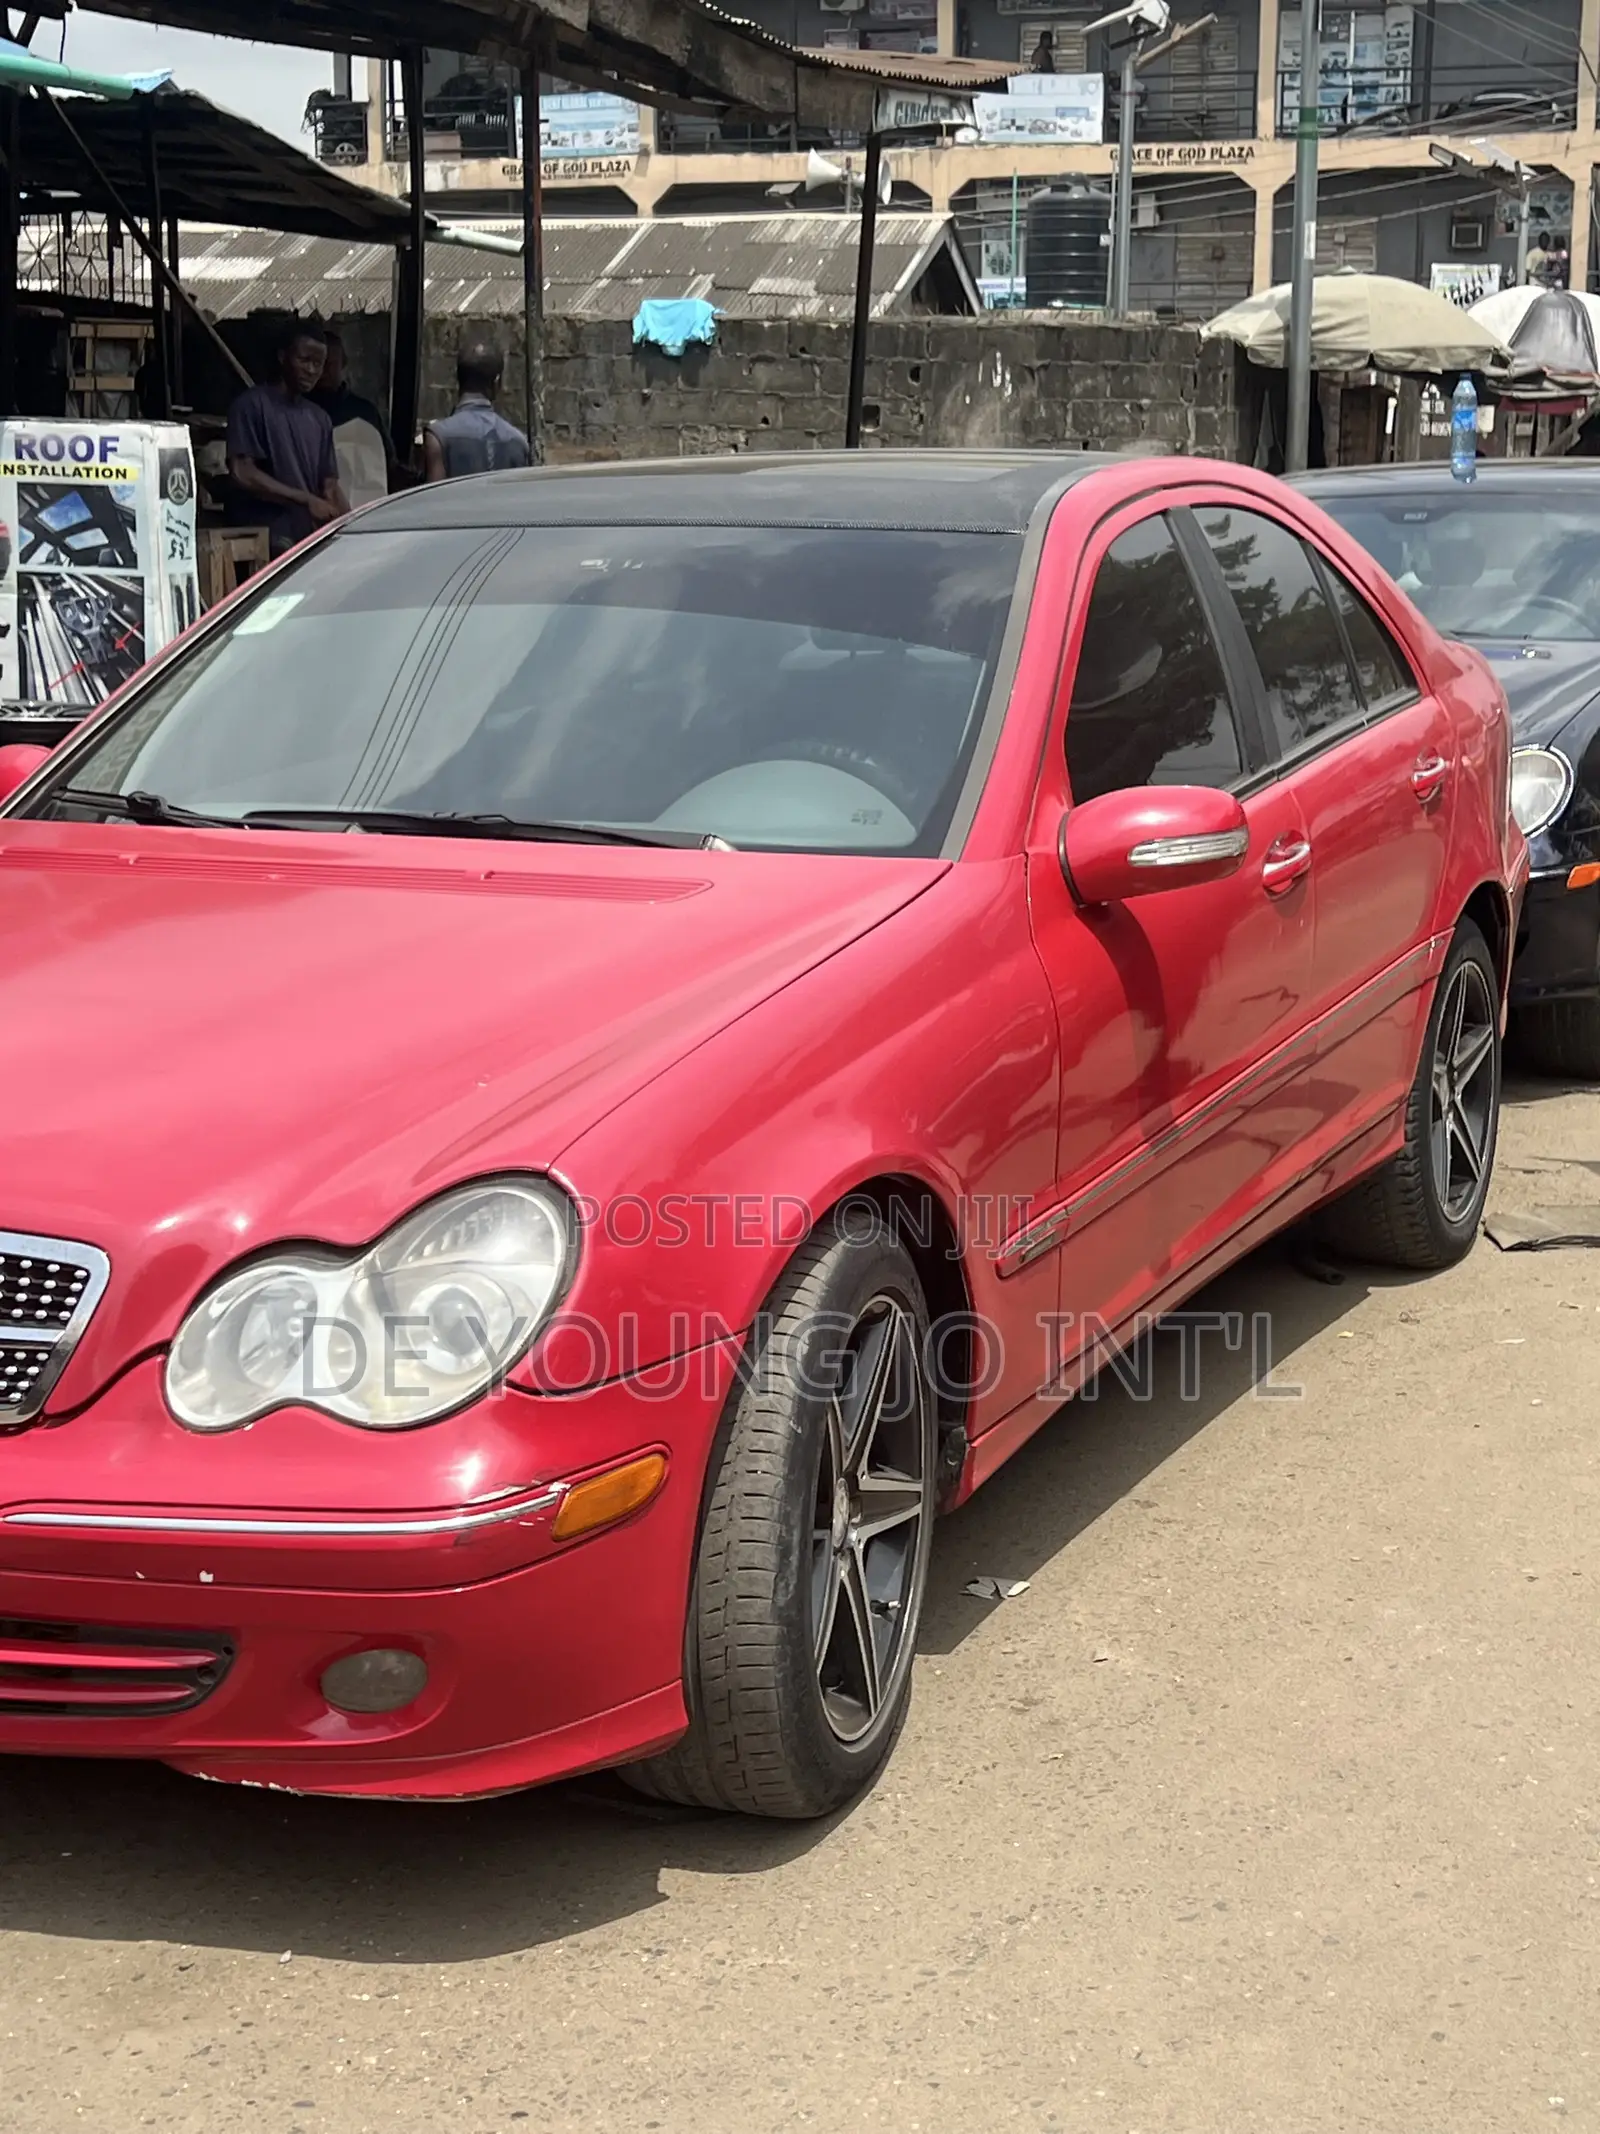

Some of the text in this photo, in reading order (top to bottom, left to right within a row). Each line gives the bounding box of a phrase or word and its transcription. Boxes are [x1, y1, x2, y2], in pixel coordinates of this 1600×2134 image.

[1110, 146, 1255, 160] GACE OF GOD PLAZA
[502, 160, 631, 176] GRA OF GOD PLAZA
[14, 433, 120, 463] ROOF
[0, 463, 127, 480] NSTALLATION
